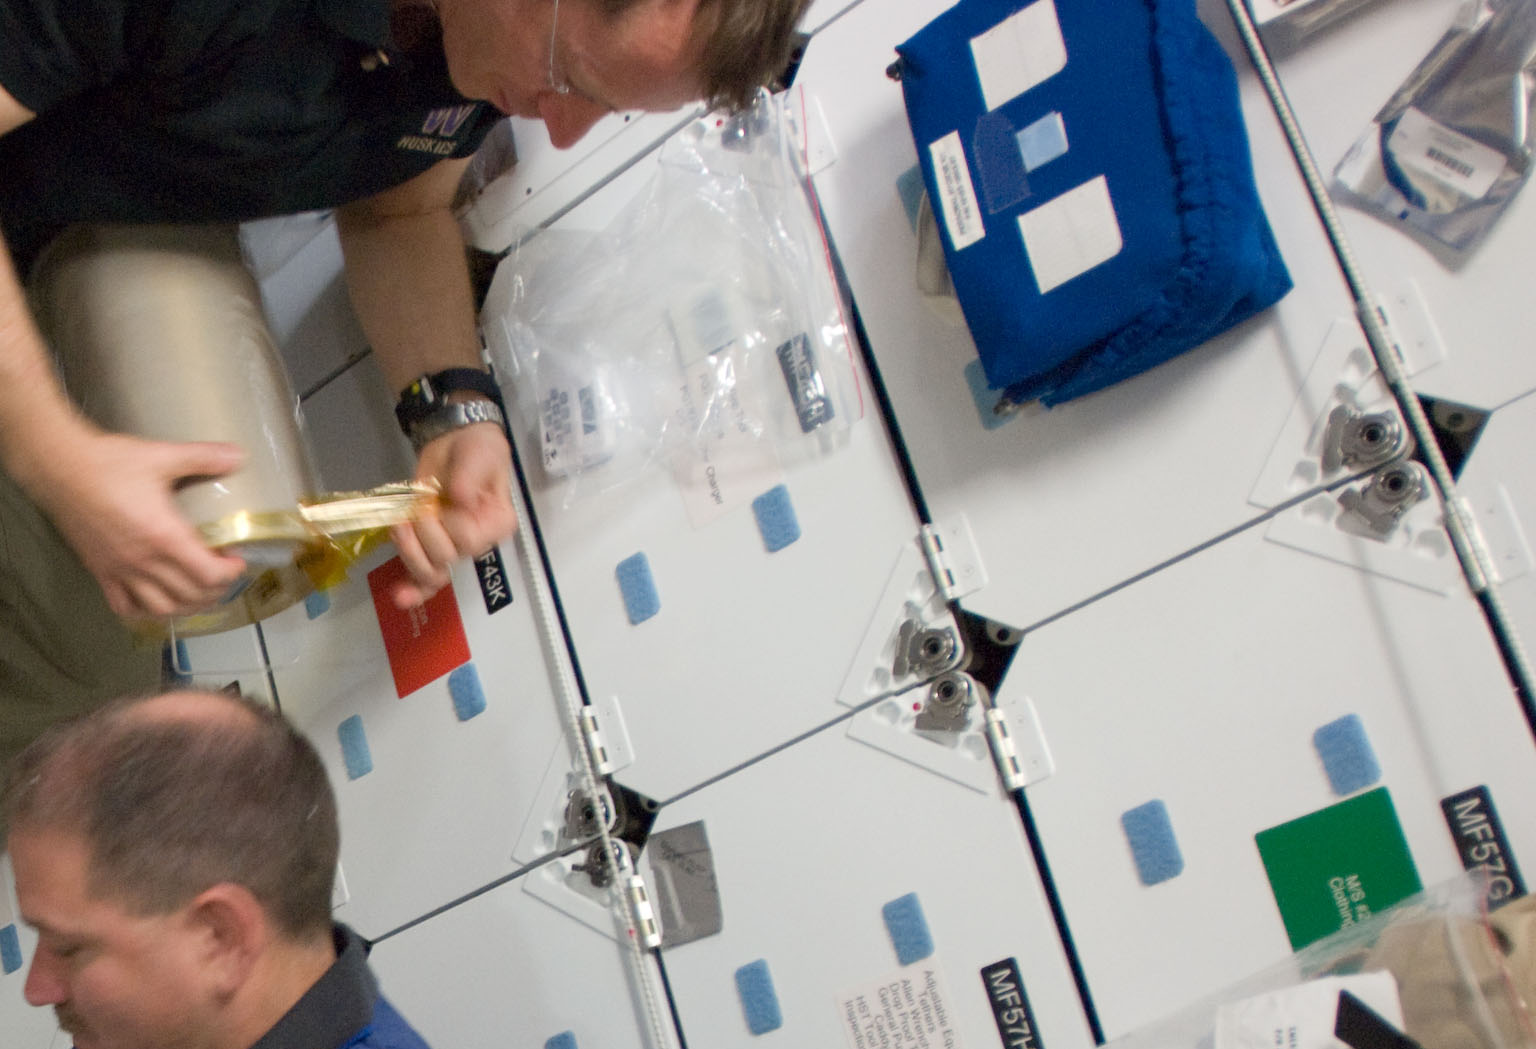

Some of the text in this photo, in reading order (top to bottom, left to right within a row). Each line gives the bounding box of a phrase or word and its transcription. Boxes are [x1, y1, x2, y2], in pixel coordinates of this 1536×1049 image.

[704, 465, 723, 504] Charger
[474, 550, 506, 605] F43K
[1455, 797, 1512, 900] MF57G
[1345, 874, 1365, 902] M/S
[877, 986, 899, 1031] General
[885, 981, 903, 1010] Drop
[897, 1011, 915, 1042] Proof
[900, 978, 914, 1006] Allen
[917, 990, 935, 1033] Tethers
[923, 969, 947, 1027] Adjustable
[864, 1022, 879, 1048] Tool
[872, 1013, 890, 1049] Caddy
